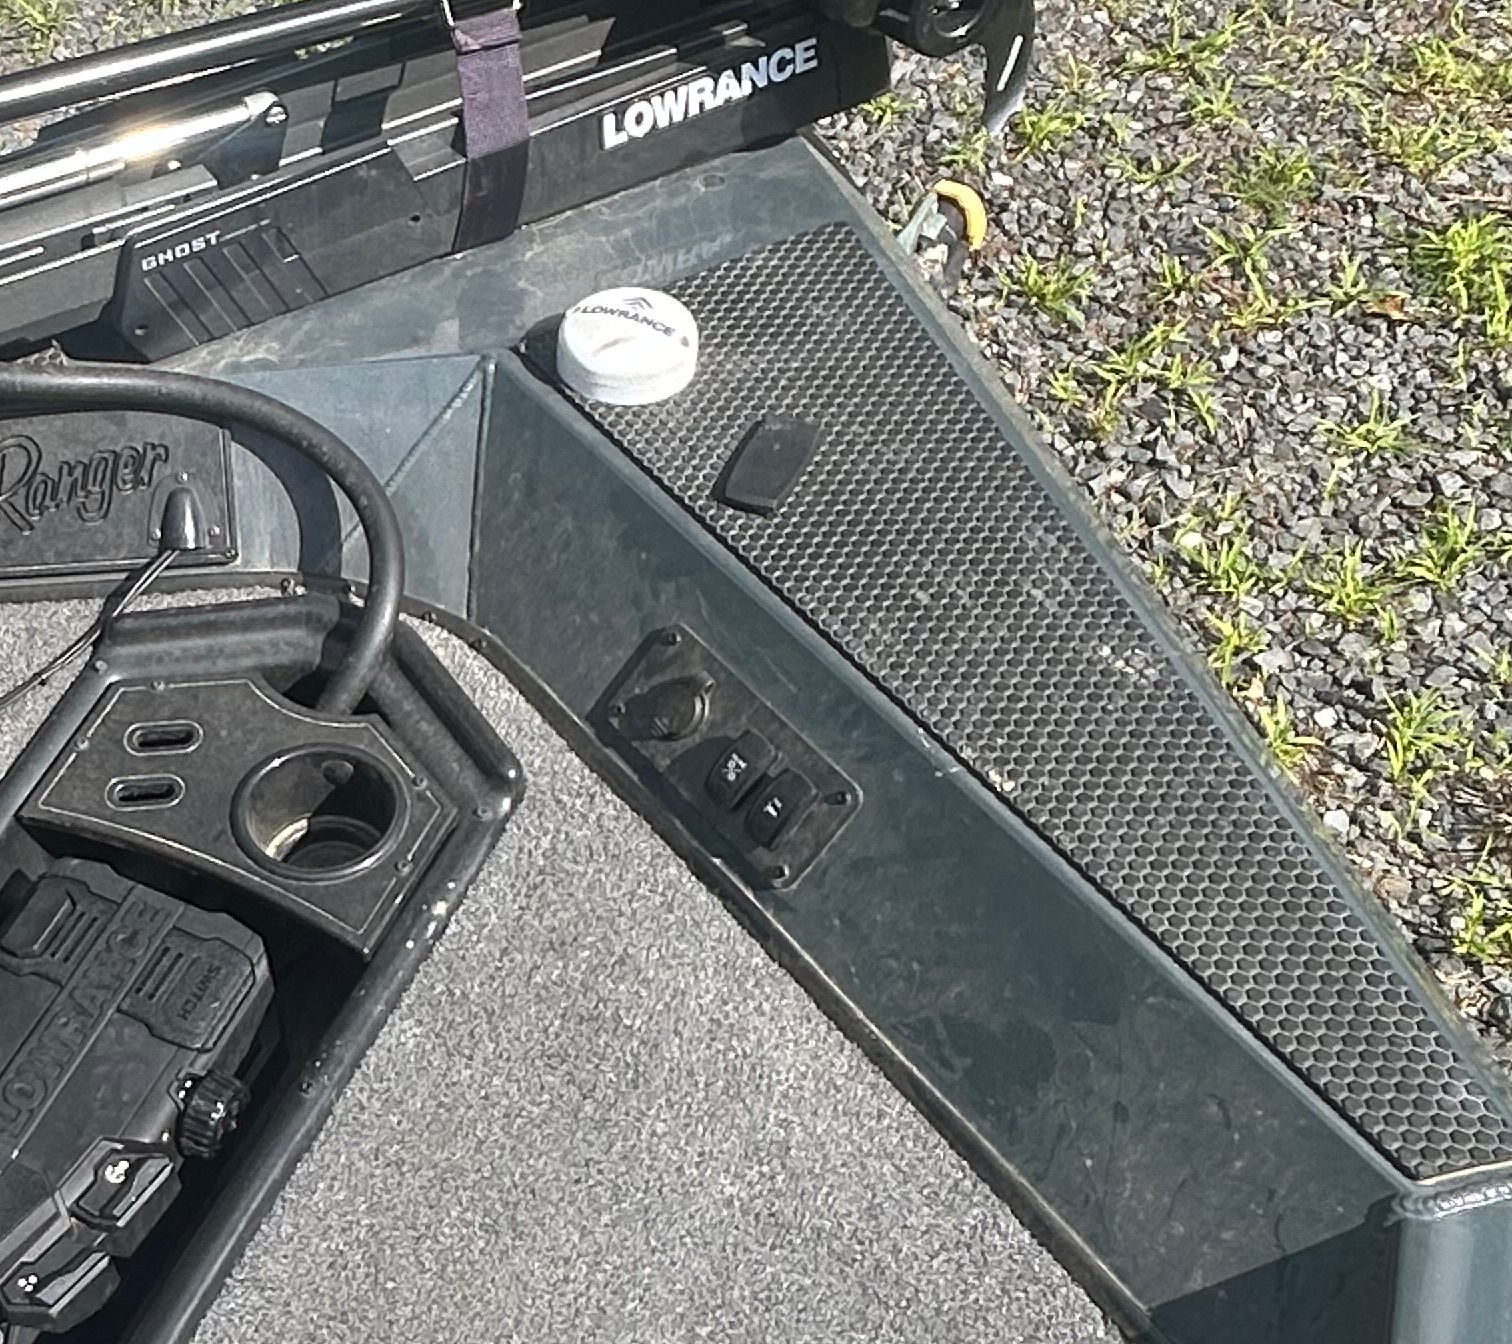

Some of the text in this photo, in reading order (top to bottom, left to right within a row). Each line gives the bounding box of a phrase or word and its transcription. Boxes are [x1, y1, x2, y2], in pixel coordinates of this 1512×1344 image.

[602, 37, 818, 151] LOWRANCE
[141, 229, 222, 272] GHOST
[581, 305, 676, 337] LOWRANCE
[177, 962, 223, 1022] SWITCH
